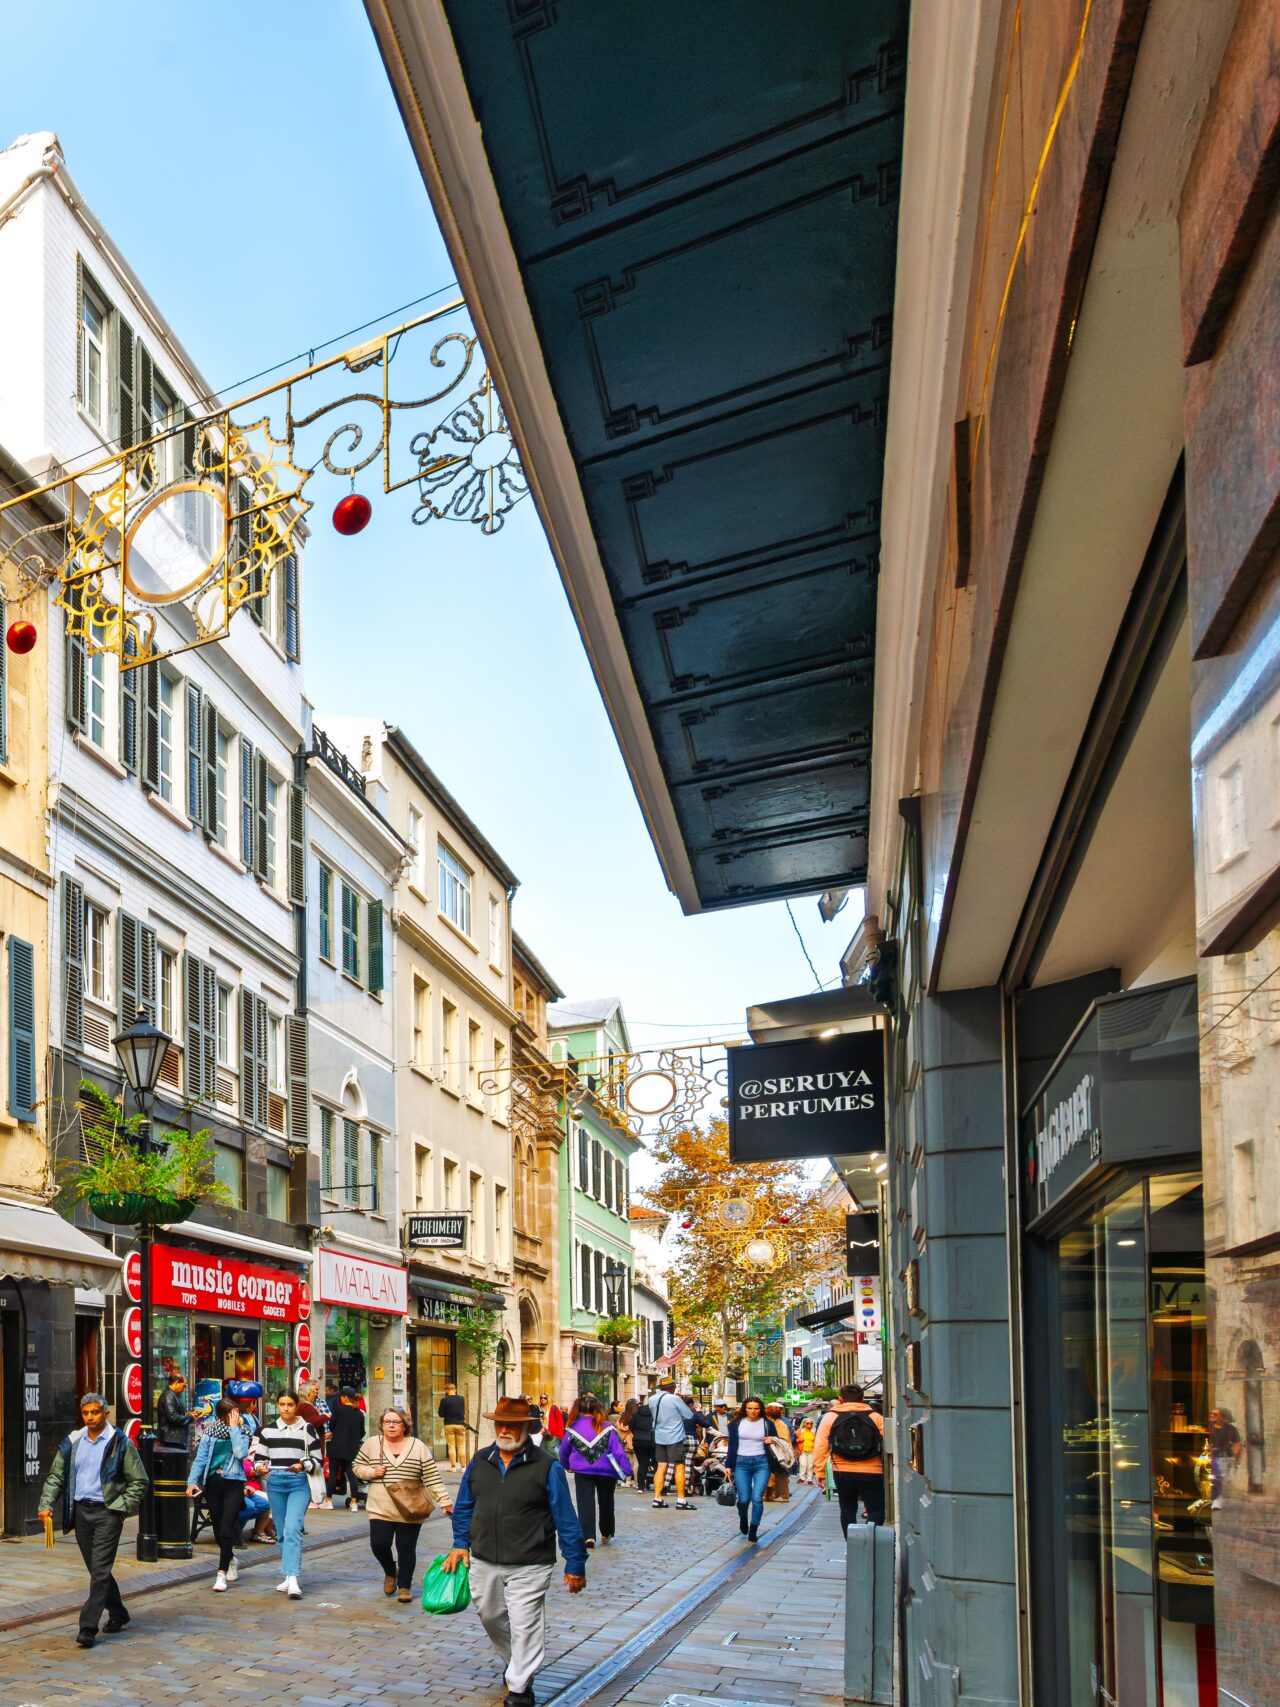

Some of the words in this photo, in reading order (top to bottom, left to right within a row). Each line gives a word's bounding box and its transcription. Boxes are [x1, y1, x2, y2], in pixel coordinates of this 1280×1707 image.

[739, 1069, 873, 1100] @SERUYA
[739, 1093, 875, 1120] PERFUMES
[411, 1220, 463, 1235] PERFUMERY
[171, 1260, 233, 1295] music
[237, 1274, 293, 1306] corner
[334, 1263, 397, 1303] MATALAN
[181, 1292, 197, 1306] TOYS
[217, 1298, 245, 1312] MOBILES
[263, 1305, 286, 1318] GADGETS
[423, 1297, 446, 1319] STAR
[25, 1387, 40, 1411] SALE
[25, 1461, 40, 1476] OFF
